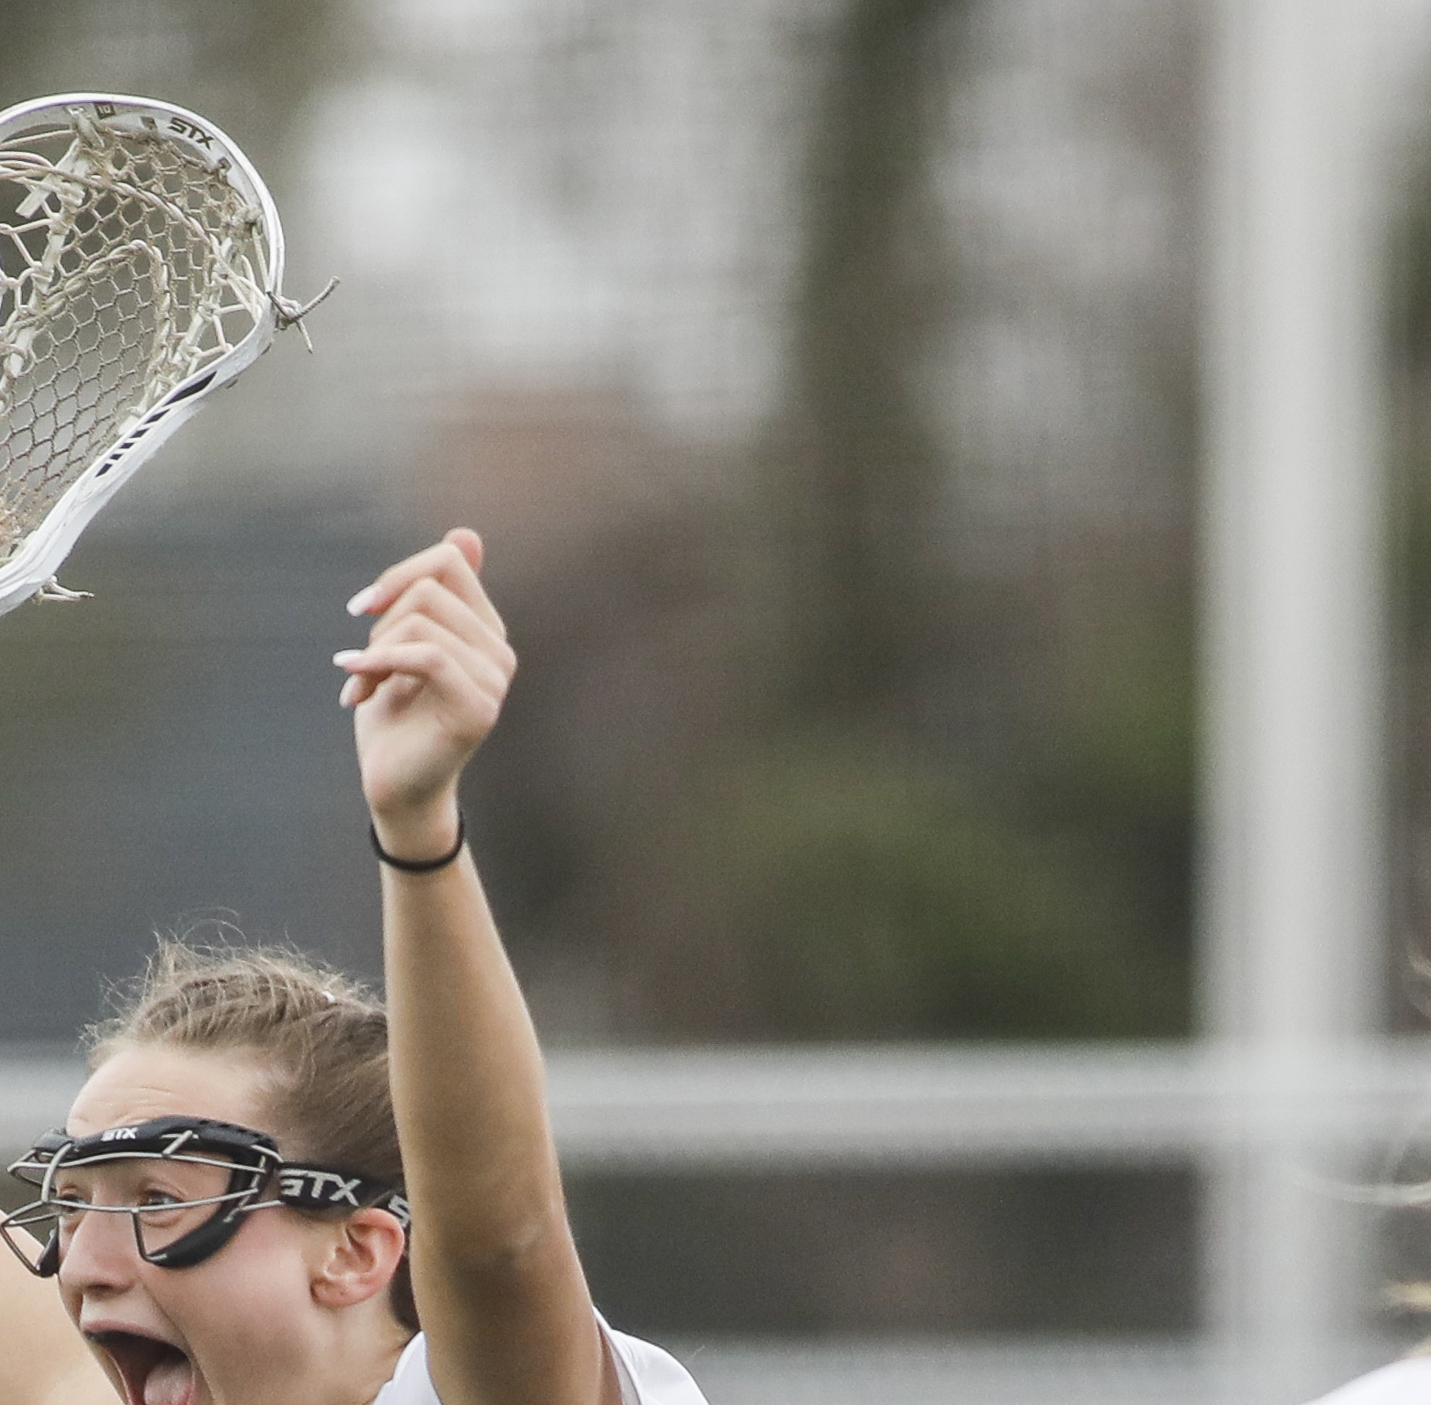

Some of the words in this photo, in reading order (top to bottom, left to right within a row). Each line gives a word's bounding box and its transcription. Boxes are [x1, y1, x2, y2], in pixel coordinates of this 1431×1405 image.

[169, 116, 215, 150] STX
[100, 1127, 139, 1141] STX
[278, 1168, 362, 1207] STX
